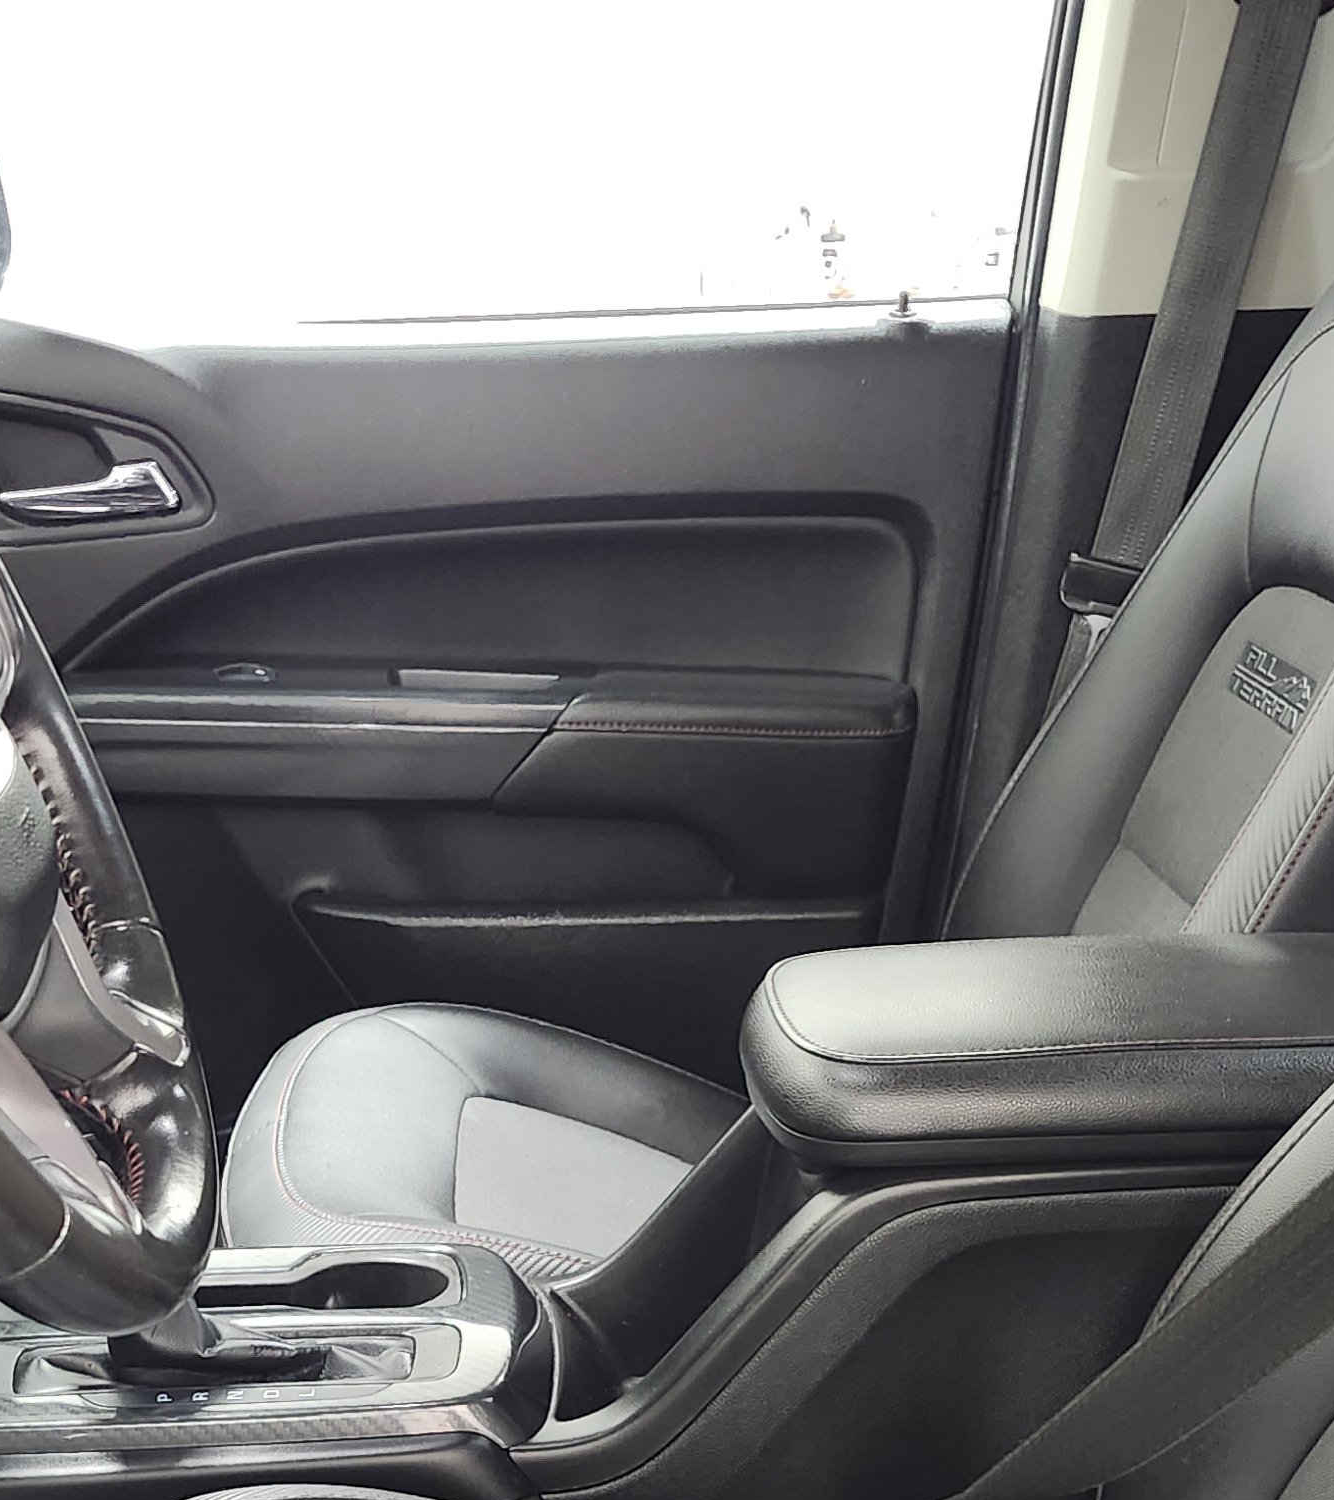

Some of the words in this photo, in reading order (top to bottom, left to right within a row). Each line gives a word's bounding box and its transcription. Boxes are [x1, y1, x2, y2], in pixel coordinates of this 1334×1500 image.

[1246, 645, 1277, 680] ALL
[1233, 677, 1299, 730] TERRAIN
[156, 1393, 173, 1403] P
[192, 1391, 210, 1402] R
[227, 1390, 245, 1400] N
[263, 1389, 280, 1399] D
[299, 1388, 316, 1398] L
